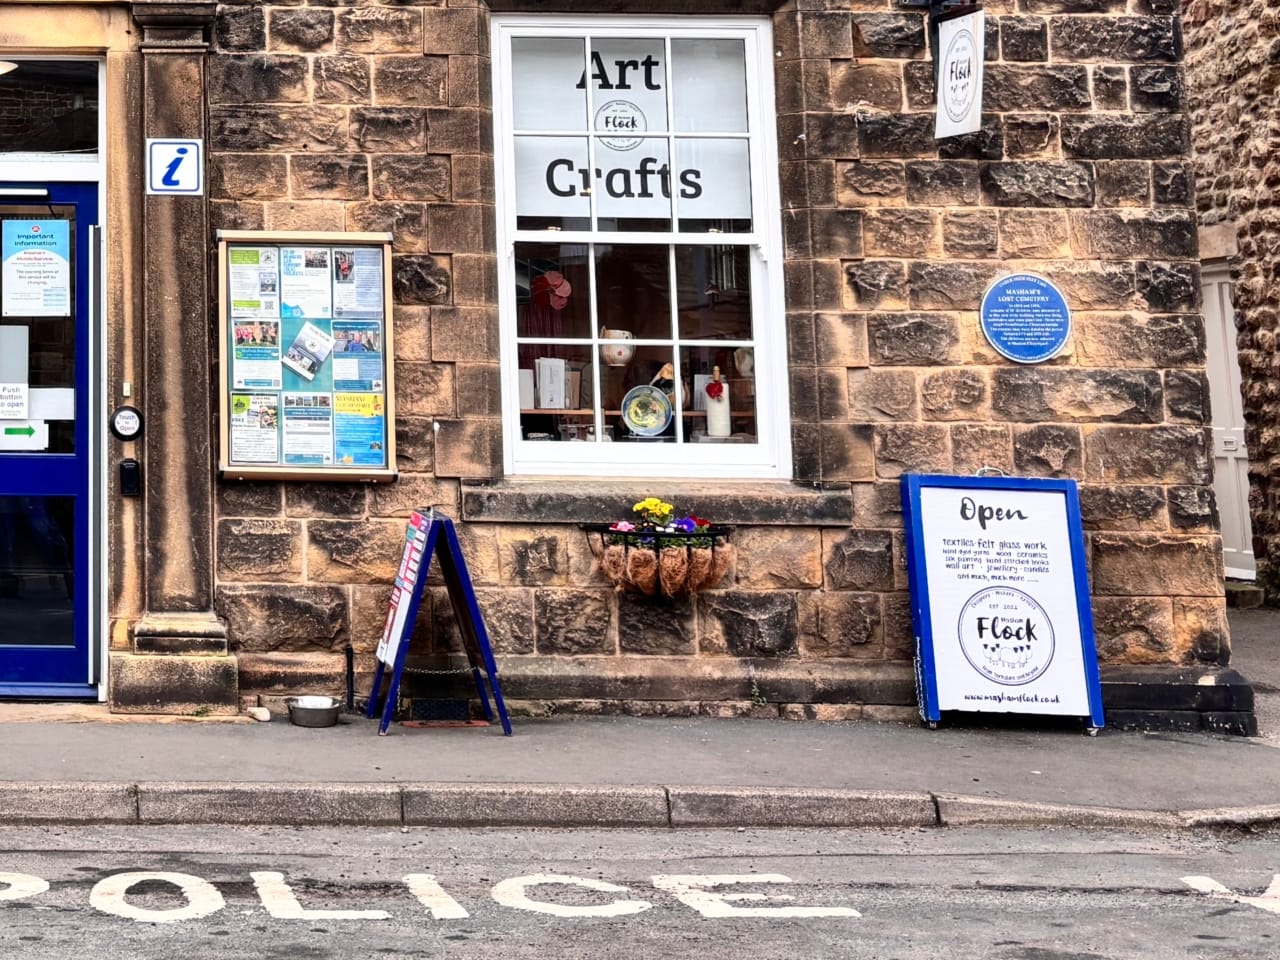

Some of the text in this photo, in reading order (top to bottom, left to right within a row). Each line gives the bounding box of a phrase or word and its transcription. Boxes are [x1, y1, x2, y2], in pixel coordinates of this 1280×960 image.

[576, 50, 662, 91] Art
[604, 115, 638, 129] Flock
[545, 156, 703, 200] Crafts
[960, 496, 1028, 530] Open
[942, 537, 1048, 551] textiles felt glass work
[957, 556, 982, 564] painting
[1017, 551, 1048, 559] ceramics
[945, 561, 1050, 574] wall art jewellery candles
[975, 615, 1038, 642] Flock
